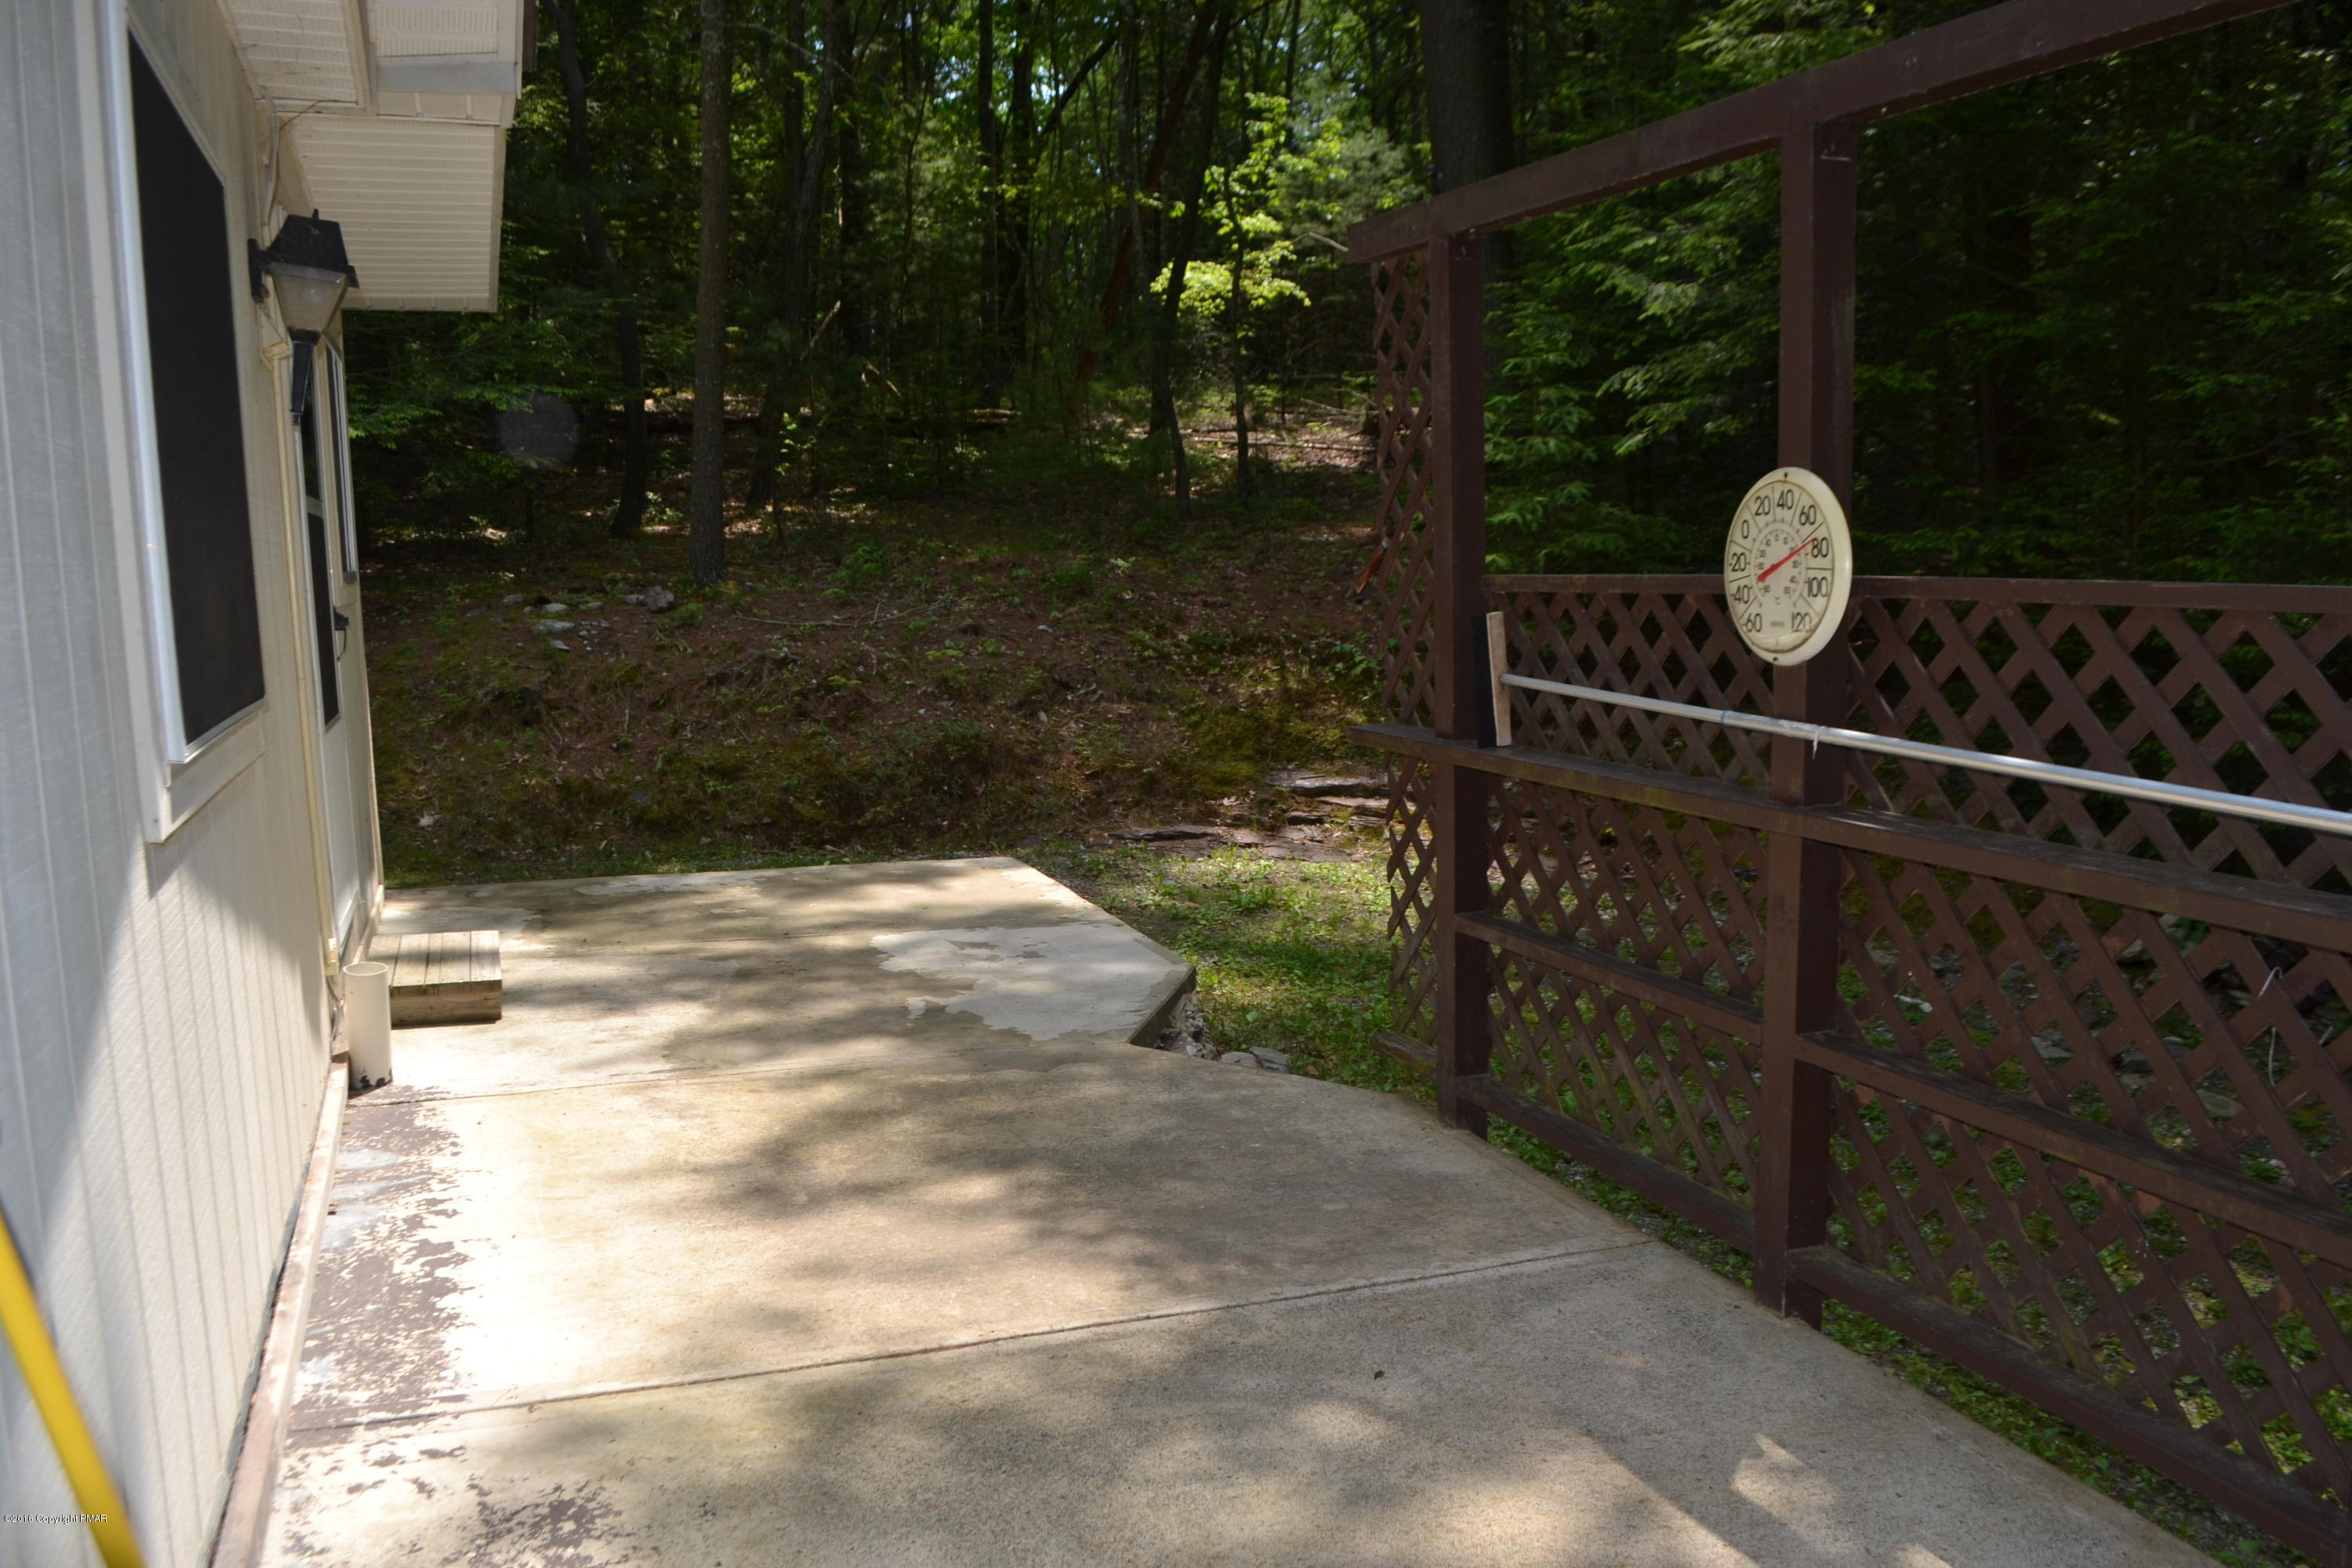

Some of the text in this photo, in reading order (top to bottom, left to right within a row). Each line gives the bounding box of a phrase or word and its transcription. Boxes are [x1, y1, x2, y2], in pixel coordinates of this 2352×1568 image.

[1755, 495, 1771, 516] 20
[1777, 489, 1795, 510] 40
[1798, 505, 1817, 525] 60
[1741, 520, 1749, 539] 0
[1812, 537, 1829, 558] 80
[1730, 552, 1747, 572] -20
[1731, 584, 1749, 604] -40
[1807, 577, 1829, 597] 100
[1791, 612, 1812, 633] 120
